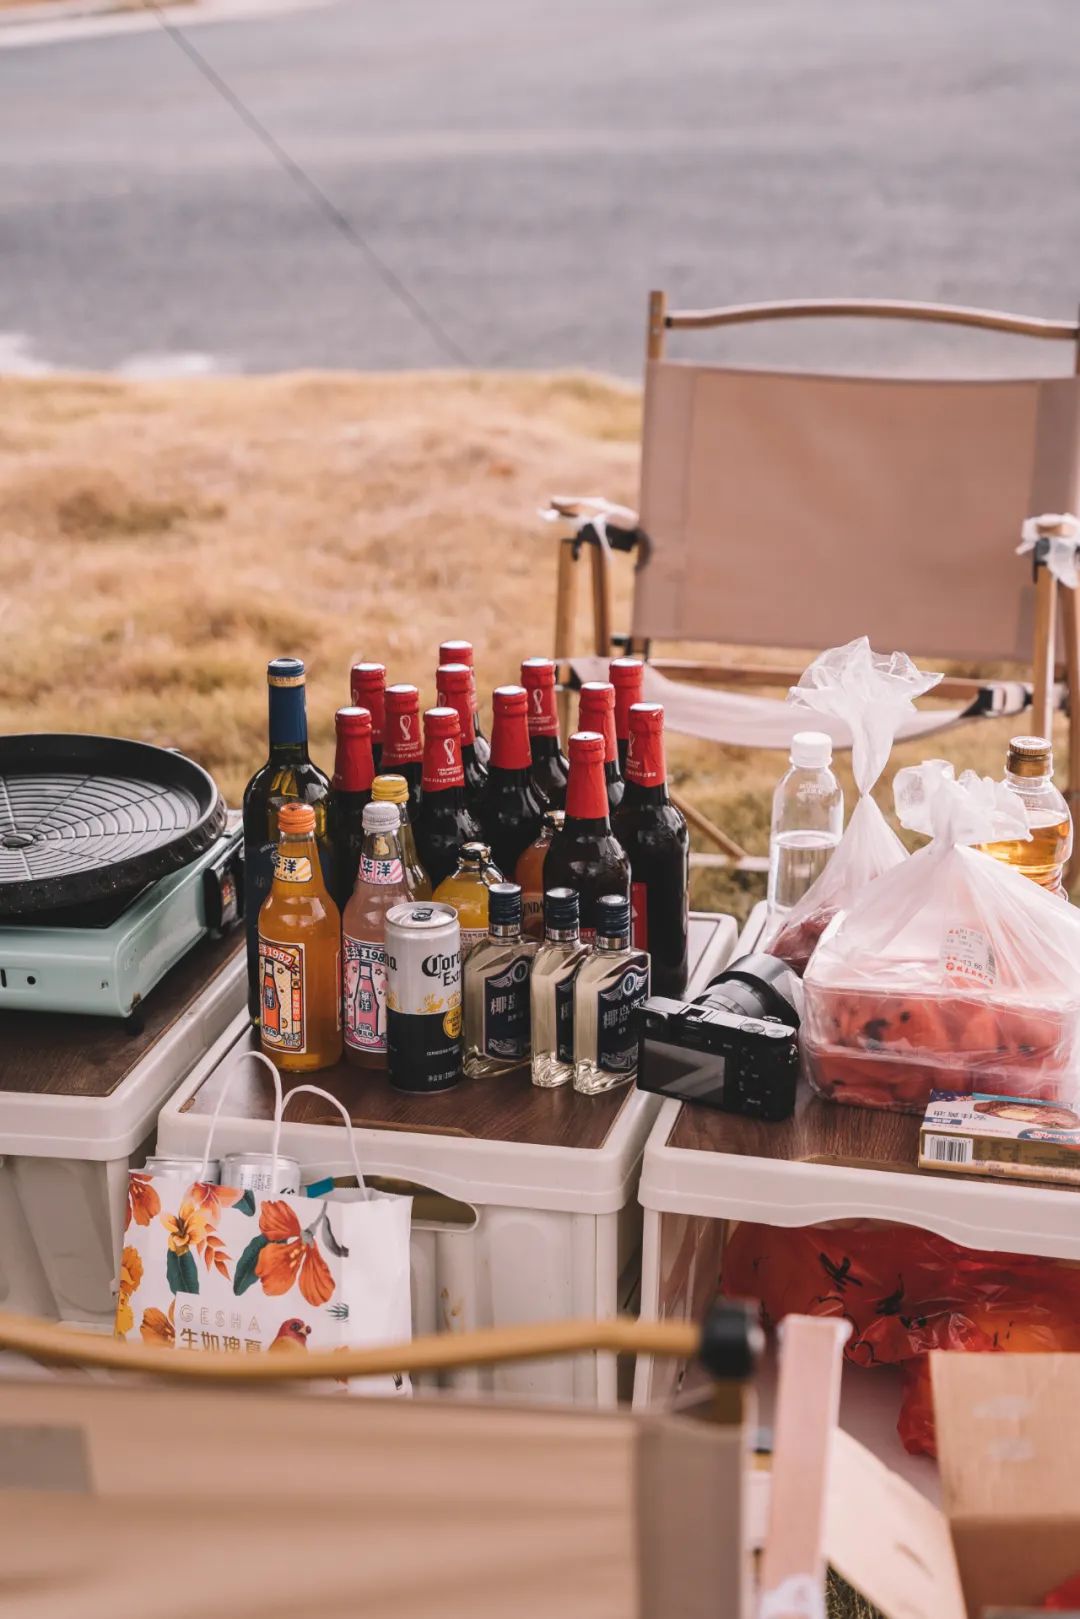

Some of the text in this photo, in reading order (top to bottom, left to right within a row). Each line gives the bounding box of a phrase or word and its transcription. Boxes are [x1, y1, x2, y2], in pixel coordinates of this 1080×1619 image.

[363, 860, 391, 876] 华洋
[443, 970, 462, 987] Ext
[180, 1304, 261, 1334] GESHA
